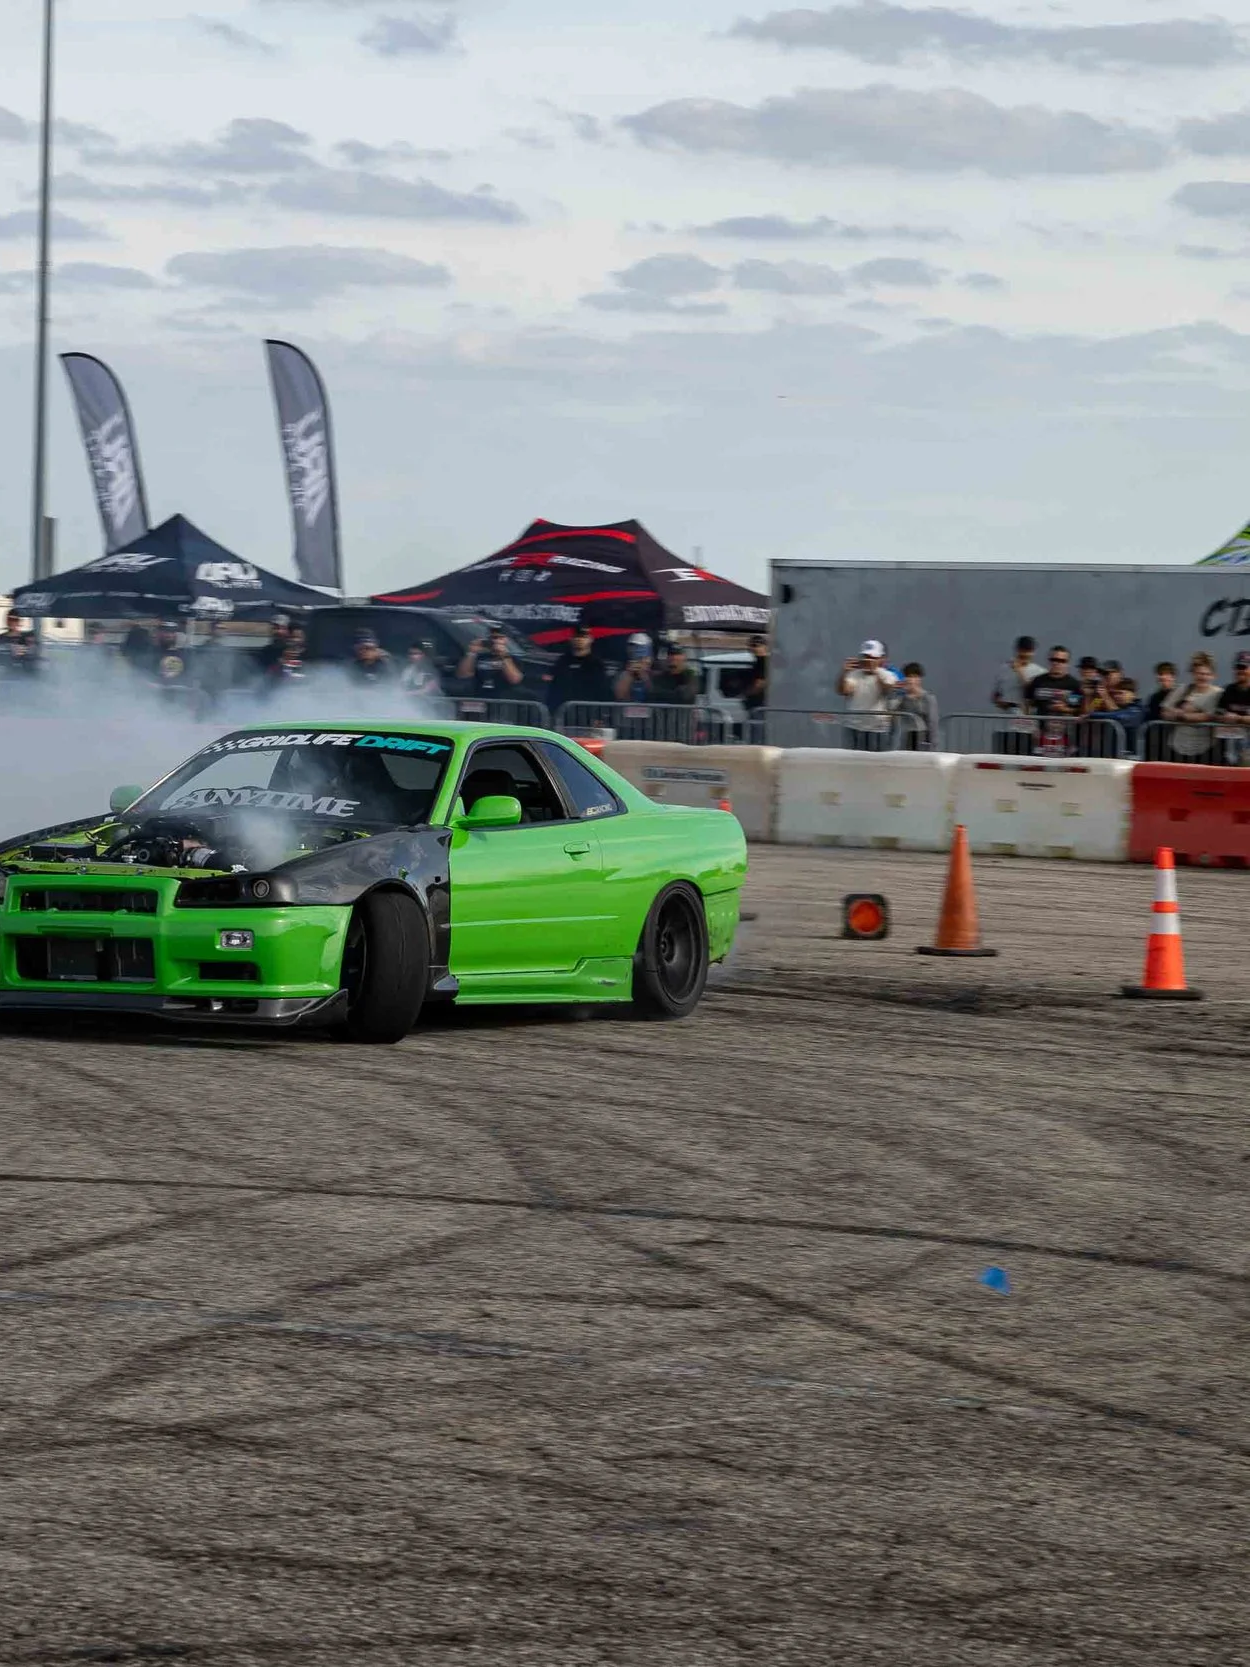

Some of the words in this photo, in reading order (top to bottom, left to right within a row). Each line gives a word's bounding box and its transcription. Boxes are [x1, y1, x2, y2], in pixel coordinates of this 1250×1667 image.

[238, 734, 365, 749] GRIDLIFE
[354, 735, 450, 754] DRIFT
[166, 787, 361, 817] ANYTIME
